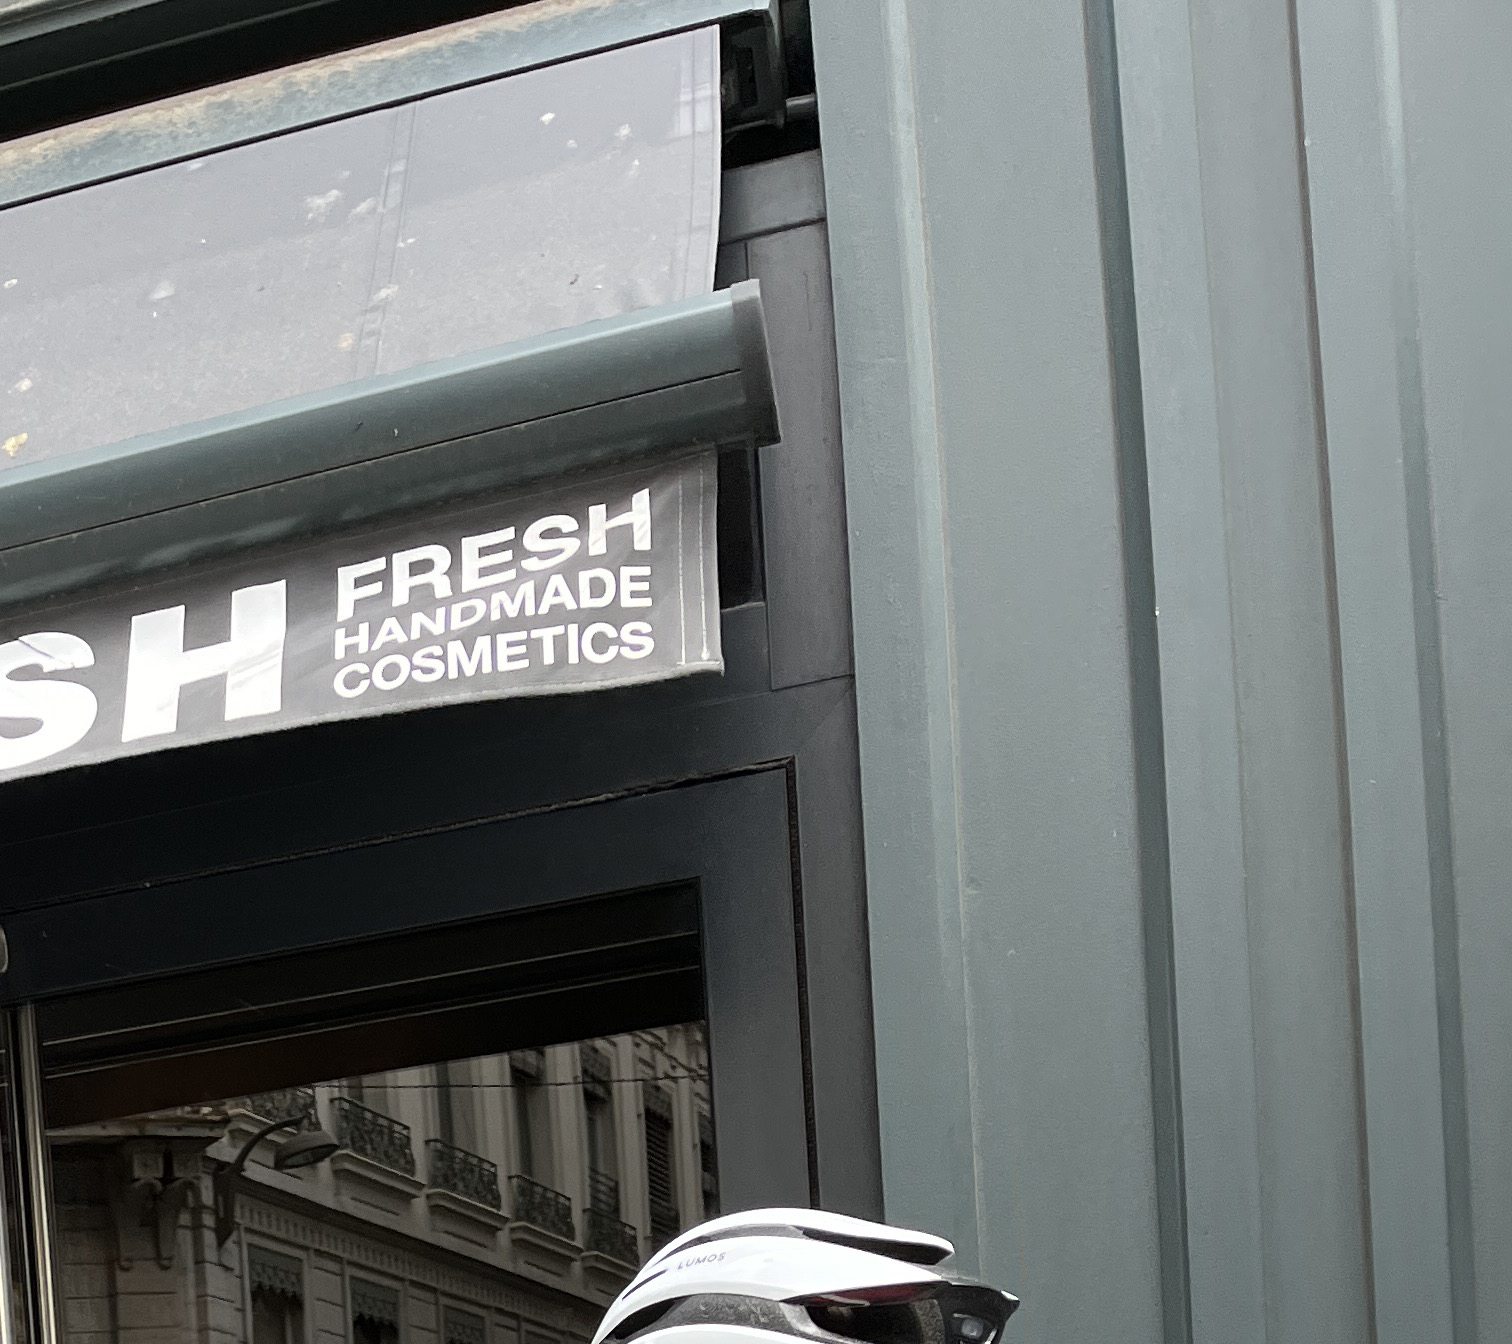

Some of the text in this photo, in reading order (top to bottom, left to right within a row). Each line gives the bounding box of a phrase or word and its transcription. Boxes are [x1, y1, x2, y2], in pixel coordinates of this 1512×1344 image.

[335, 488, 651, 623] FRESH
[333, 565, 653, 660] HANDMADE
[333, 621, 656, 699] COSMETICS
[678, 1252, 727, 1270] LUMOS
